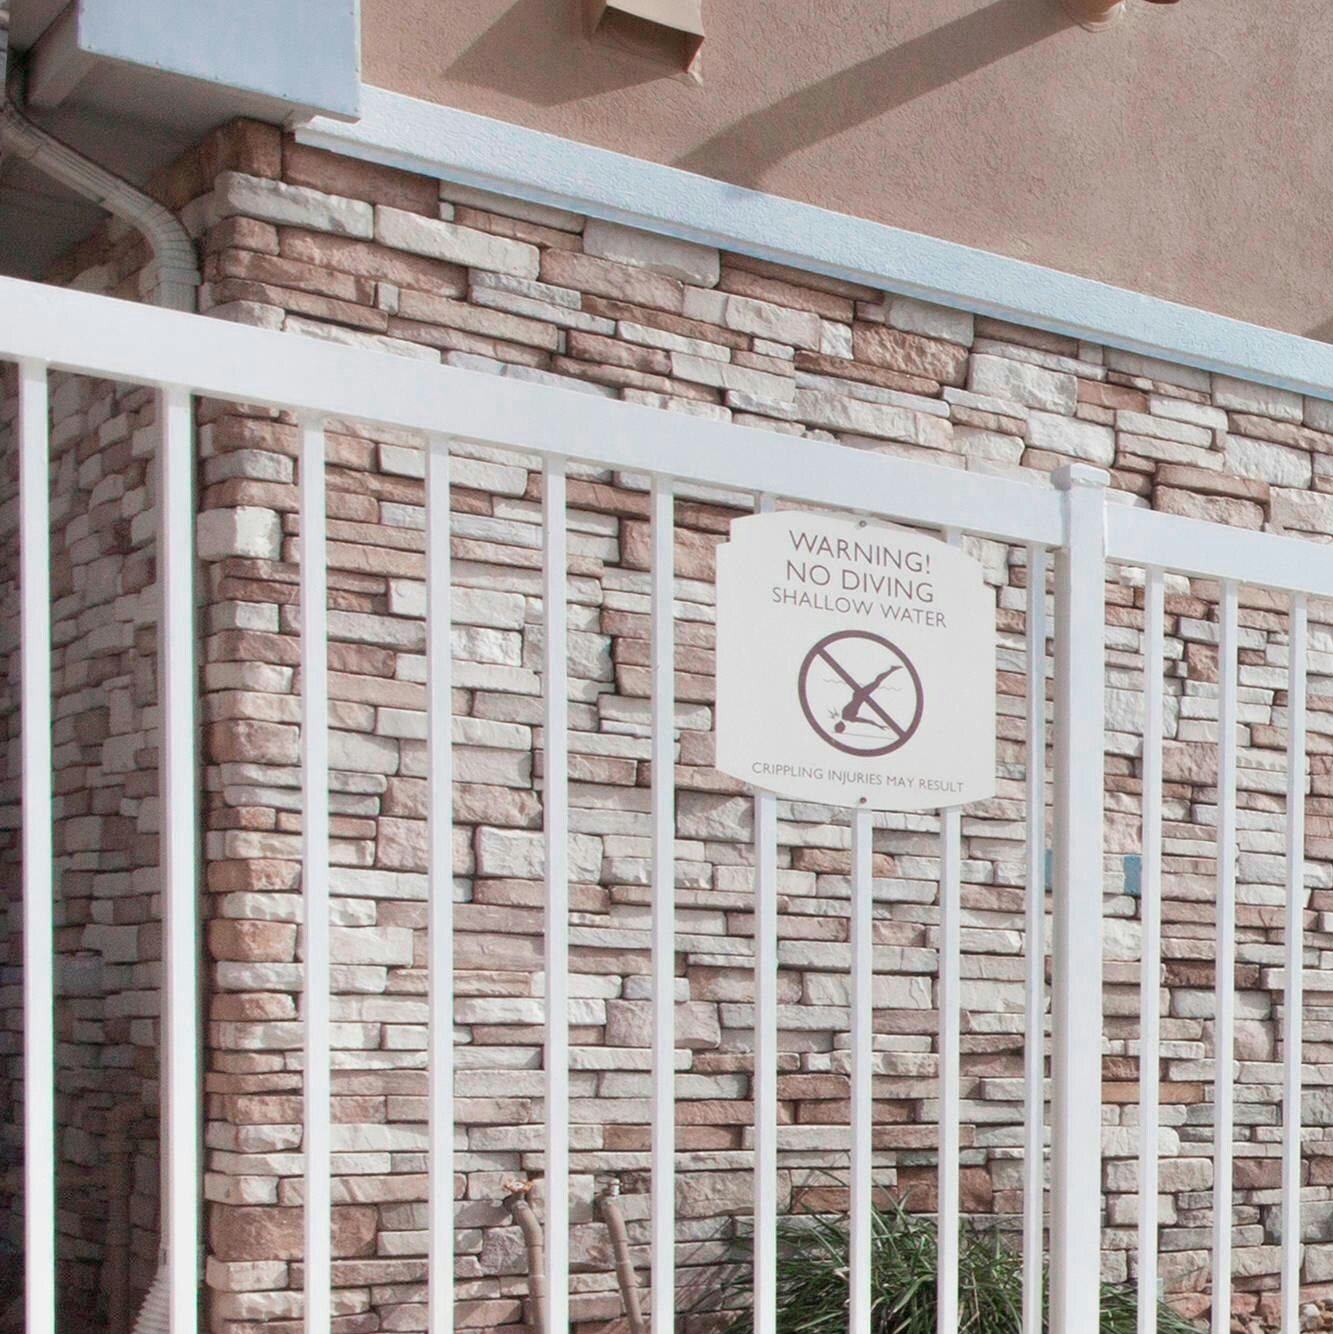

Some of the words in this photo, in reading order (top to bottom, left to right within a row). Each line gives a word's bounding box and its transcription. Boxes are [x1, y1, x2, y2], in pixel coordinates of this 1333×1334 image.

[788, 529, 931, 575] WARNING!
[786, 559, 831, 586] NO
[841, 569, 934, 603] DIVING
[771, 586, 874, 617] SHALLOW
[880, 603, 947, 629] WATER
[751, 761, 824, 780] CRIPPLING
[827, 769, 882, 786] INJURIES
[886, 775, 915, 789] MAY
[918, 777, 965, 793] RESULT
